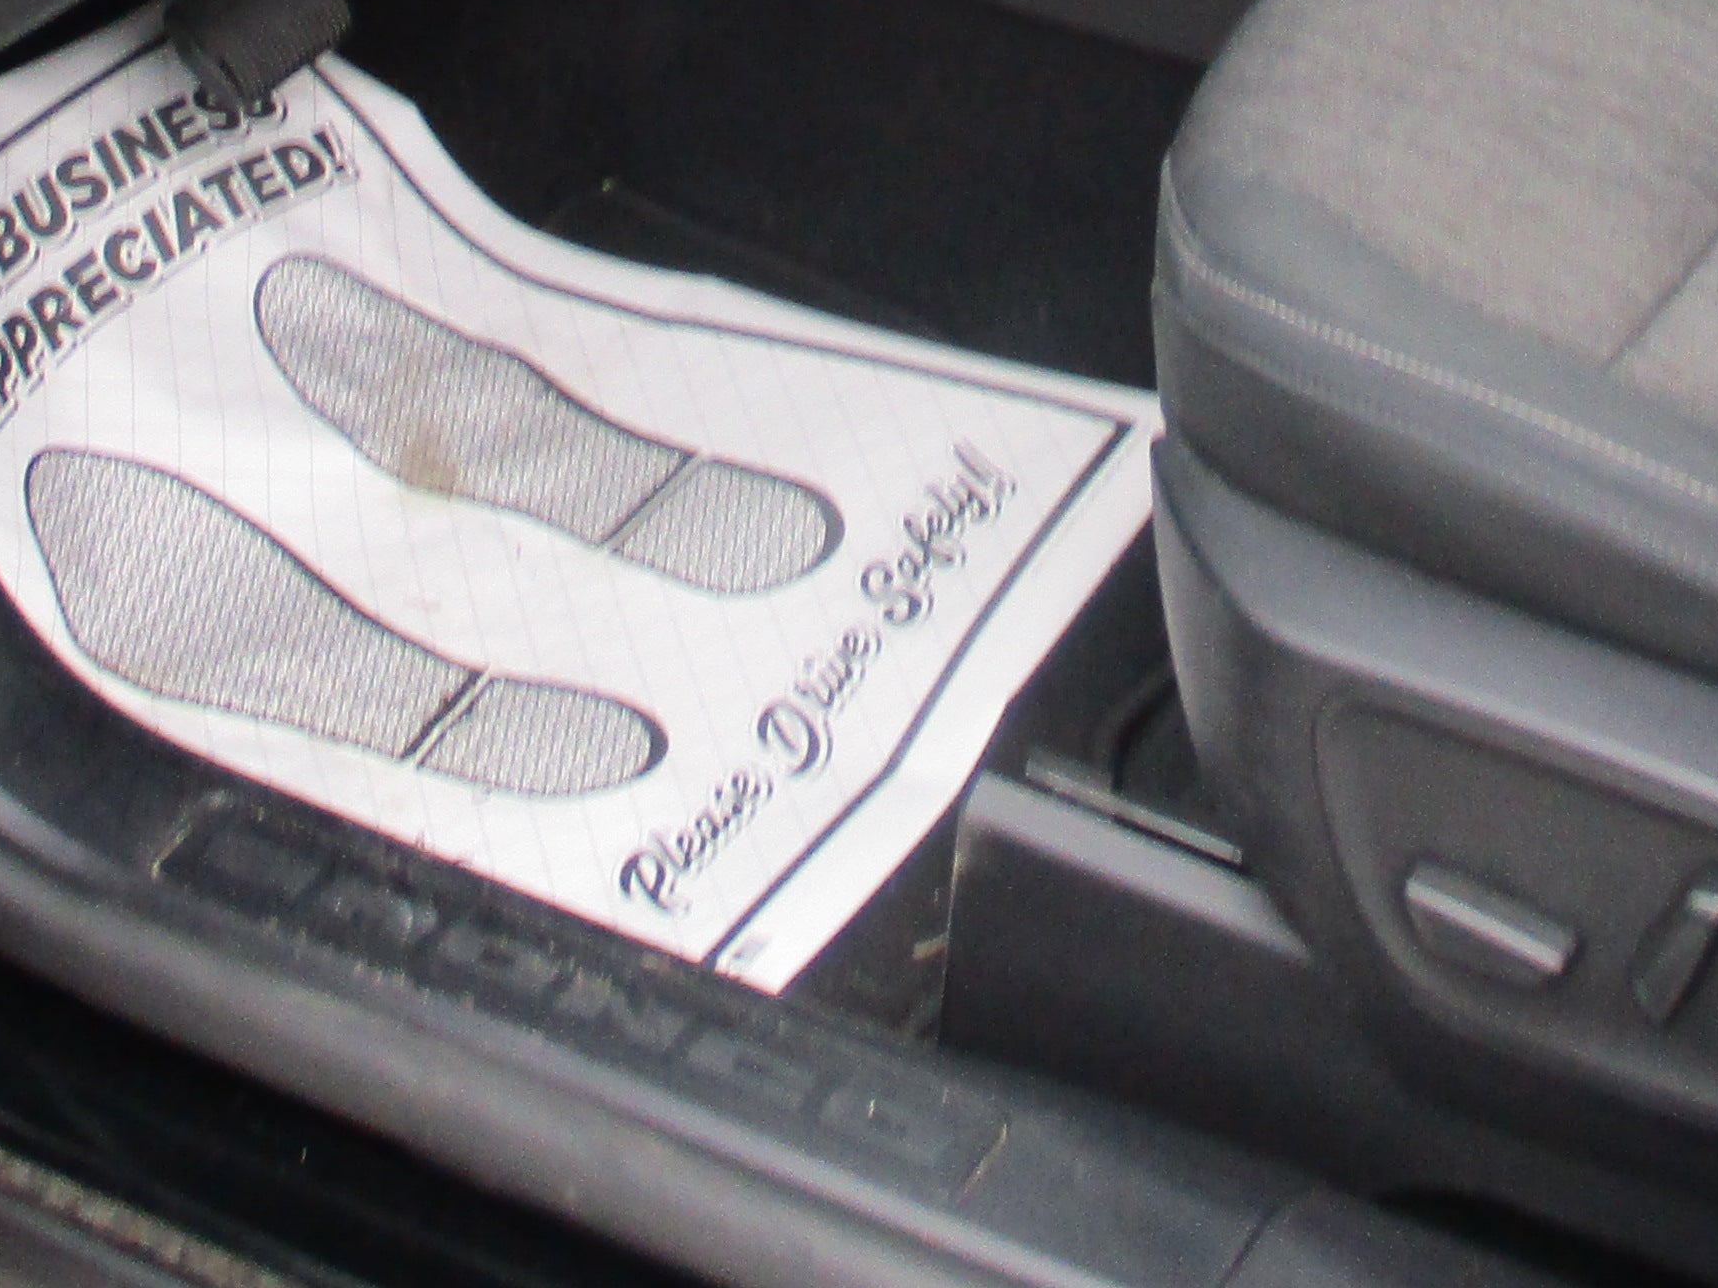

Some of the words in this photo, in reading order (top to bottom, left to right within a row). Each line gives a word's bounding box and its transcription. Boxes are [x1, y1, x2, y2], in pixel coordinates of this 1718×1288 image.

[619, 770, 765, 911] Please
[757, 628, 871, 777] Drive
[860, 441, 1007, 625] Safely!
